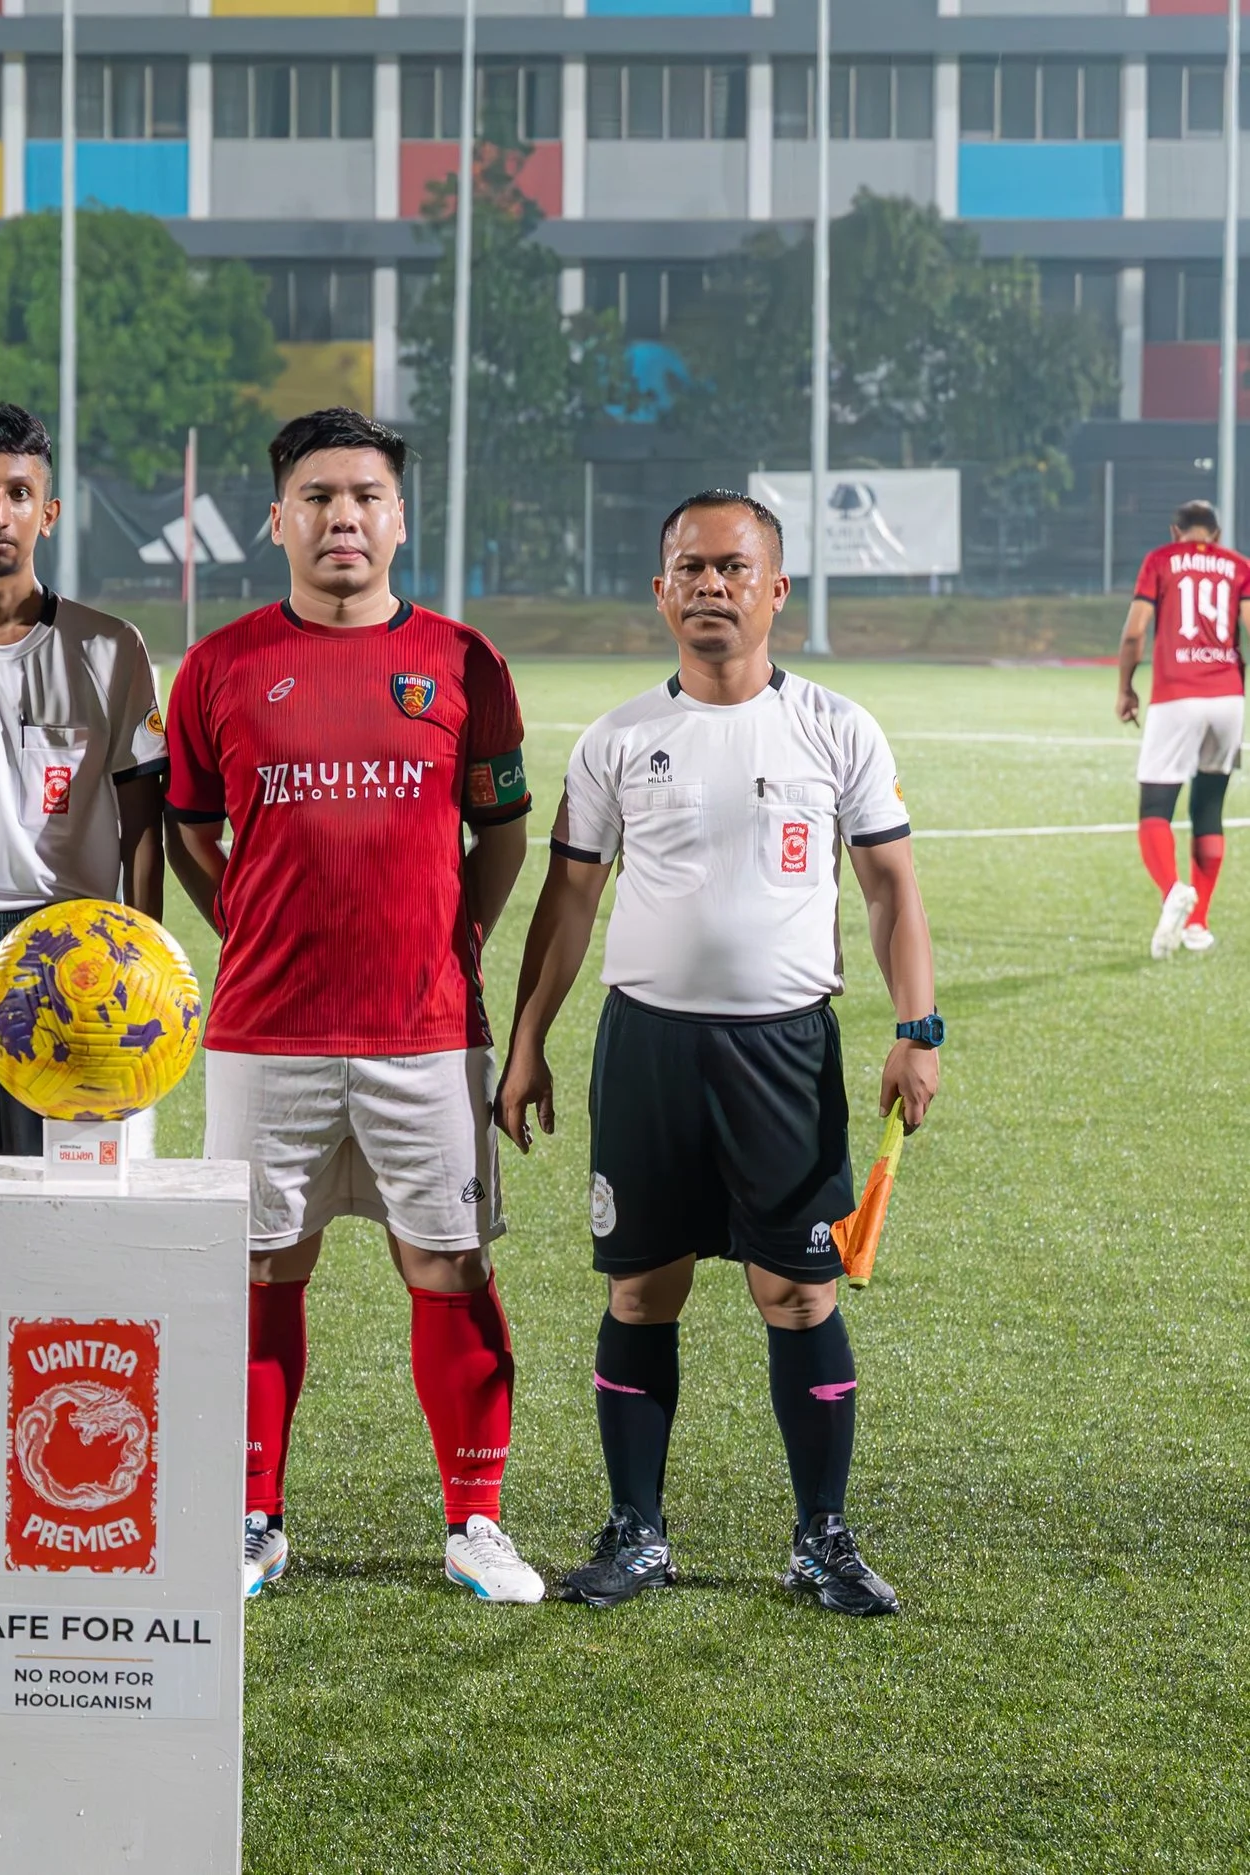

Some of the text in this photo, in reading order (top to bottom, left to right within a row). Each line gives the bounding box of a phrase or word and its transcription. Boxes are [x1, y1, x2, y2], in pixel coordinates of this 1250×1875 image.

[1178, 576, 1230, 642] 14
[647, 774, 673, 784] MILLS
[295, 786, 421, 801] HOLDINGS
[806, 1245, 831, 1254] MILLS
[27, 1339, 138, 1378] VANTRA
[21, 1513, 142, 1553] PREMIER
[62, 1616, 134, 1642] FOR
[144, 1619, 212, 1644] ALL
[14, 1668, 154, 1686] NO ROOM FOR
[14, 1693, 152, 1710] HOOLIGANISM
